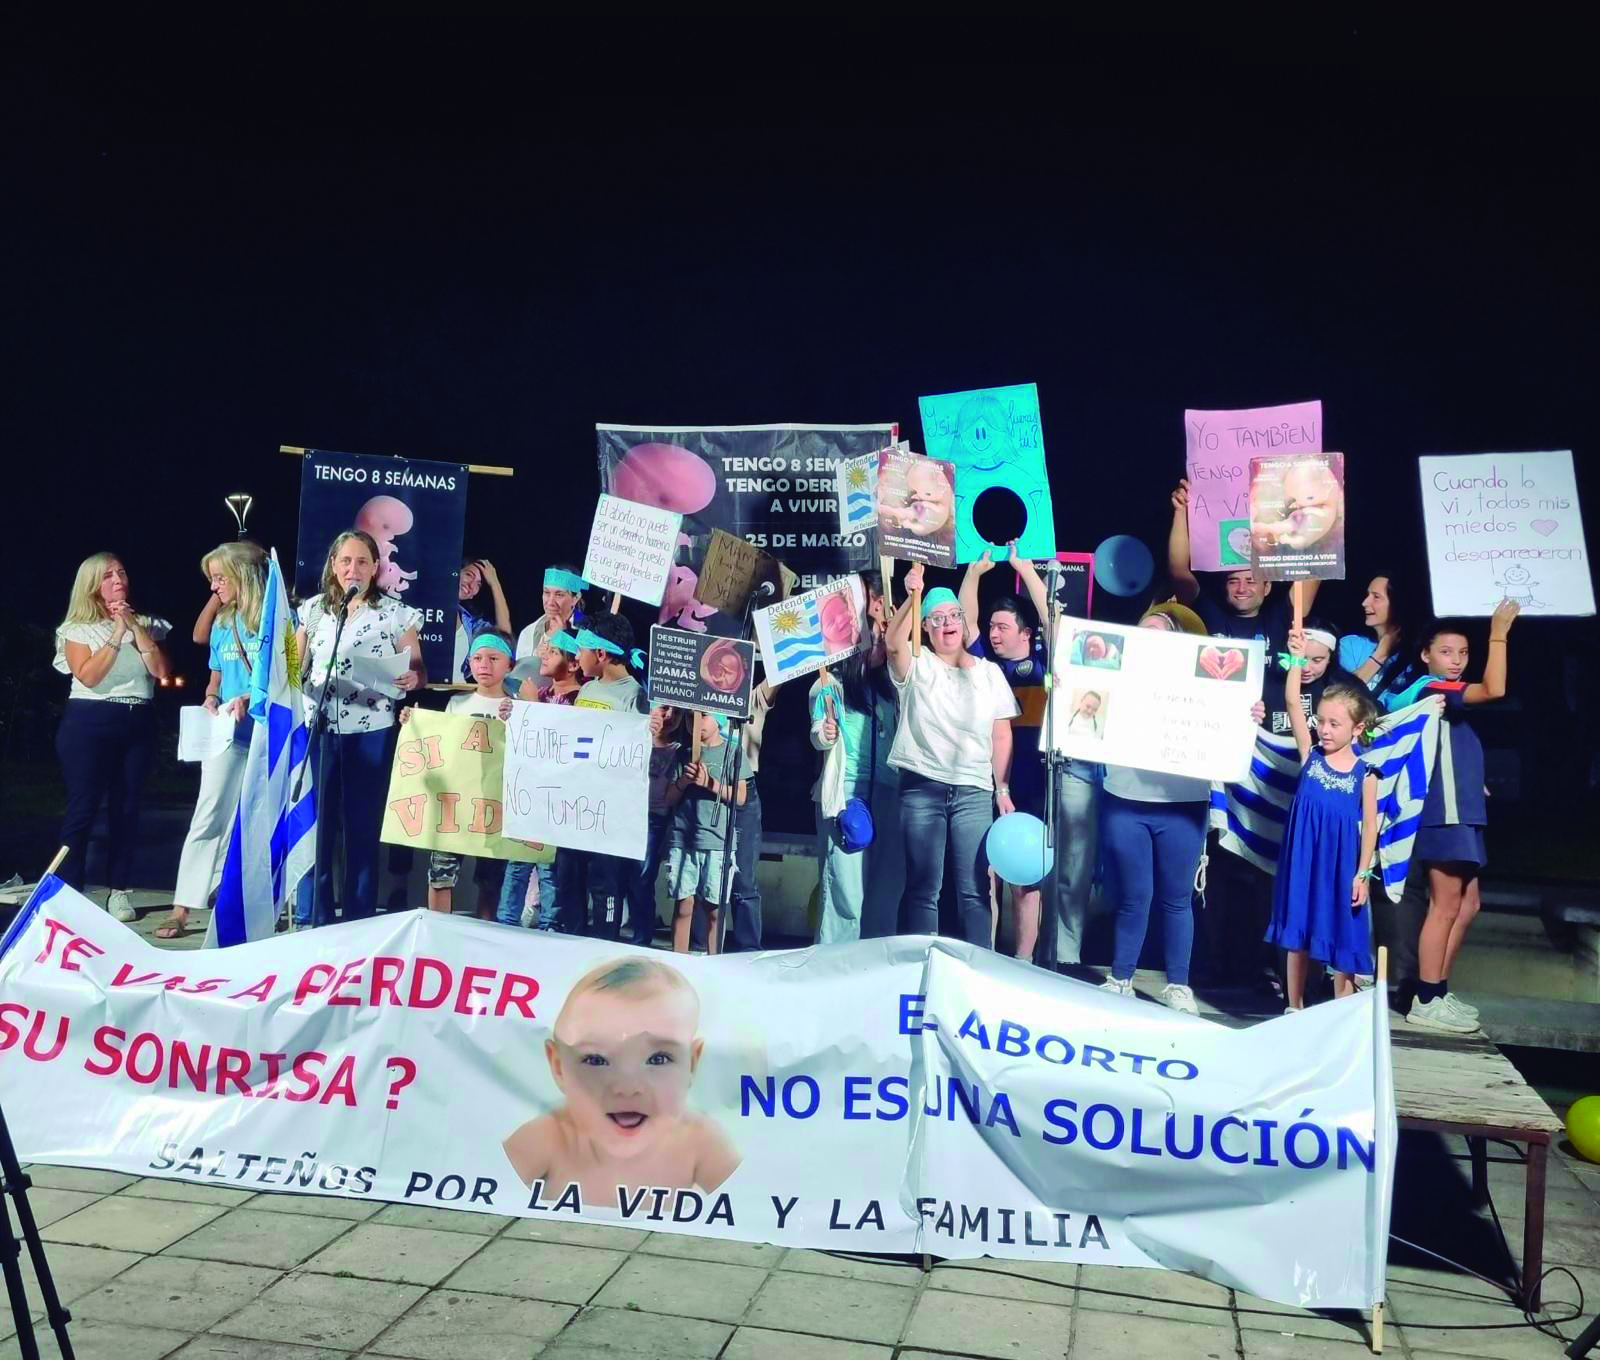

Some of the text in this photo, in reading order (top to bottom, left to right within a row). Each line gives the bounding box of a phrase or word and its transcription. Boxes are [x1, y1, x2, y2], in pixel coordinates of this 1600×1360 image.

[1192, 421, 1219, 450] YO
[722, 457, 850, 472] TENGO 8 SEM
[1188, 462, 1242, 482] TENGO
[1433, 463, 1535, 492] Cuando lo
[314, 465, 456, 491] TENGO 8 SEMANAS
[726, 478, 840, 493] TENGO DERE
[609, 503, 635, 525] aborto
[770, 499, 838, 513] A VIVIR
[1195, 492, 1249, 518] A Vi
[1478, 490, 1530, 513] todos
[1538, 496, 1570, 511] mis
[1445, 513, 1517, 536] miedos
[745, 534, 768, 547] 25
[772, 534, 797, 547] DE
[804, 533, 866, 548] MARZO
[884, 535, 905, 544] TENGO
[1445, 534, 1582, 576] desaparecieron
[767, 578, 851, 616] Defender la VIDA
[416, 608, 444, 624] ER
[657, 634, 697, 646] DESTRUIR
[666, 650, 682, 660] vida
[653, 683, 695, 698] HUMANO!
[398, 720, 493, 777] SI A
[389, 792, 503, 837] VID
[506, 768, 608, 835] NO TUMBA
[35, 918, 105, 972] TE
[227, 974, 278, 1002] A
[292, 956, 540, 1020] PERDER
[0, 1002, 417, 1111] SU SONRISA ?
[958, 1008, 1199, 1080] ABORTO
[740, 1074, 1376, 1173] NO ES UNA SOLUCIÓN
[149, 1141, 1110, 1250] SALTEÑOS POR LA VIDA Y LA FAMILIA
